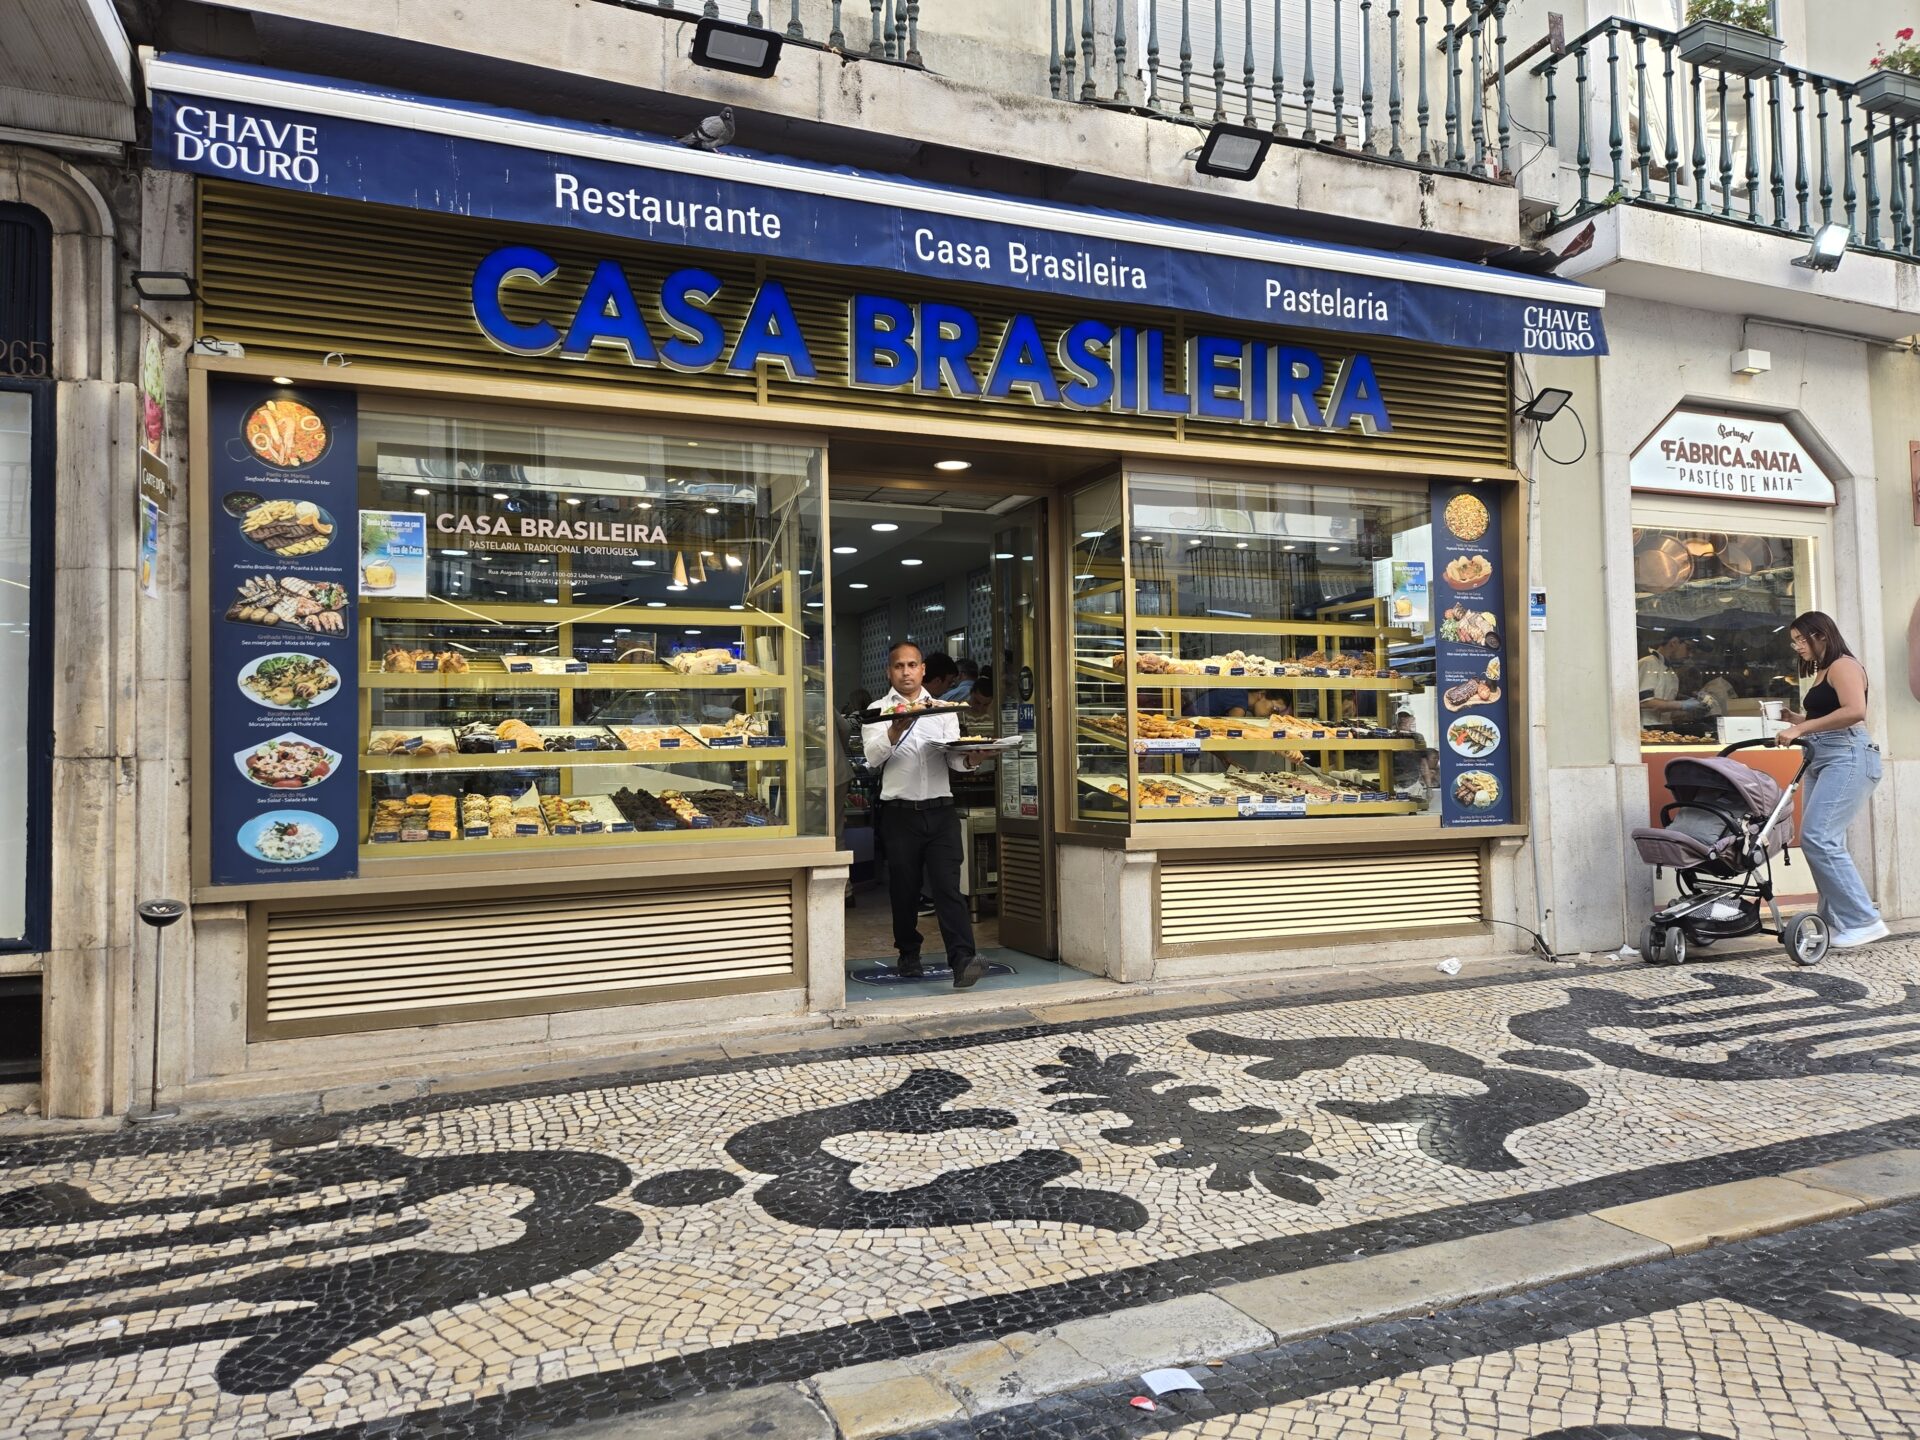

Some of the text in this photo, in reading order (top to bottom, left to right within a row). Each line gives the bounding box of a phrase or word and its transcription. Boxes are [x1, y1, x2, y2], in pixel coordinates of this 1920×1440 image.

[175, 105, 318, 155] CHAVE
[174, 132, 320, 184] D'OURO
[555, 173, 781, 239] Restaurante
[914, 228, 1147, 289] Casa Brasileira
[1265, 279, 1389, 321] Pastelaria
[1524, 306, 1591, 331] CHAVE
[471, 245, 1394, 436] CASA BRASILEIRA
[1523, 327, 1595, 351] D'OURO
[1717, 423, 1754, 444] Portugal
[1660, 437, 1747, 468] FÁBRICA
[1751, 449, 1802, 474] NATA
[1680, 467, 1793, 492] PASTÉIS DE NATA
[436, 513, 668, 544] CASA BRASILEIRA
[469, 540, 639, 557] PASTELARIA TRADICIONAL PORTUGUESA
[500, 569, 523, 577] Augusta
[578, 571, 596, 579] Lisboa
[600, 573, 623, 581] Portugal
